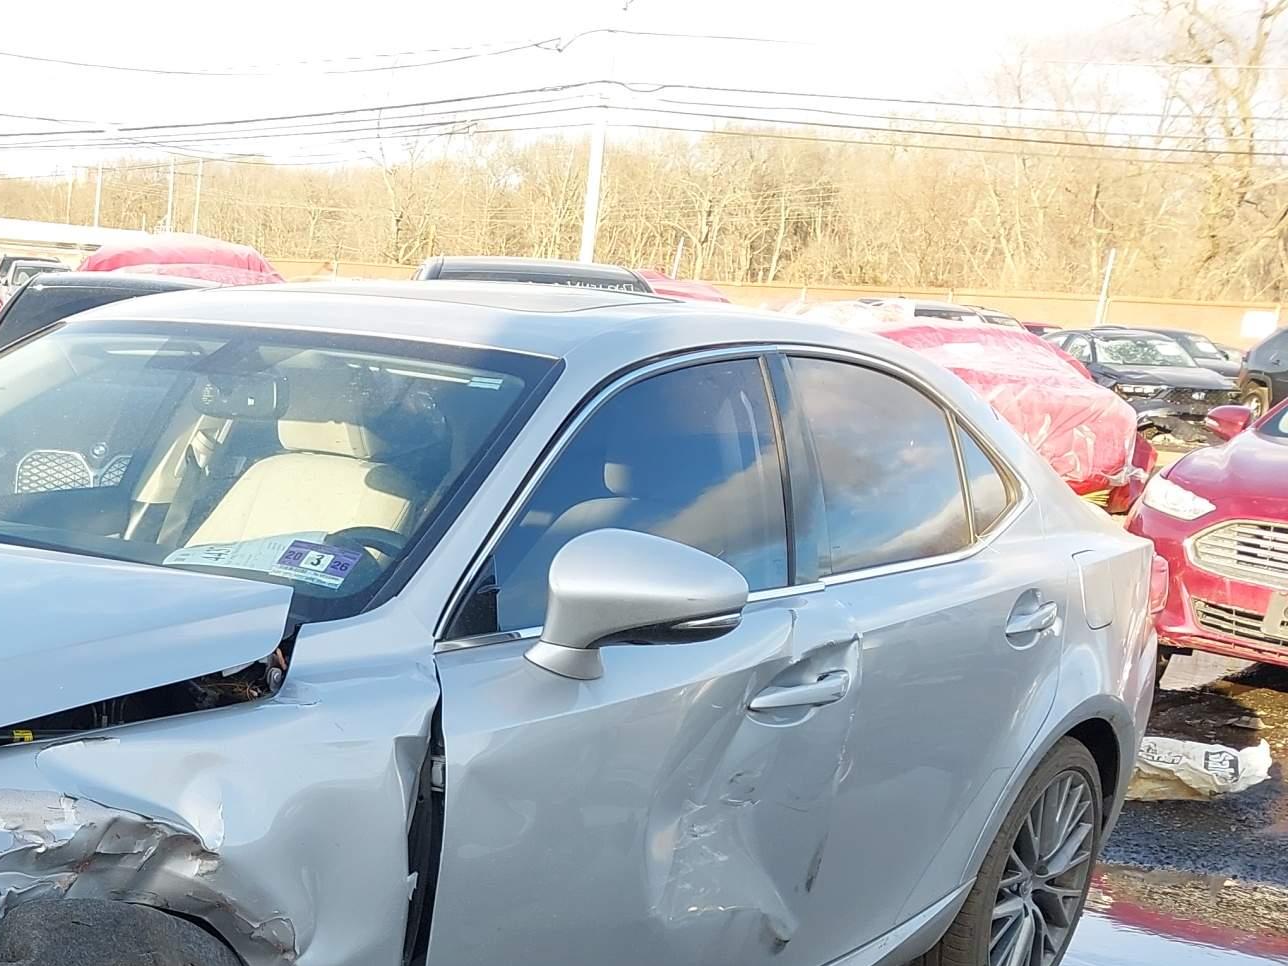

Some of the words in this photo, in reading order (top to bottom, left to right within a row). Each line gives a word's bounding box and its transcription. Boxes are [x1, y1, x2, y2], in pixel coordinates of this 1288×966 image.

[285, 550, 304, 561] 20
[310, 554, 325, 567] 3
[330, 560, 351, 572] 26
